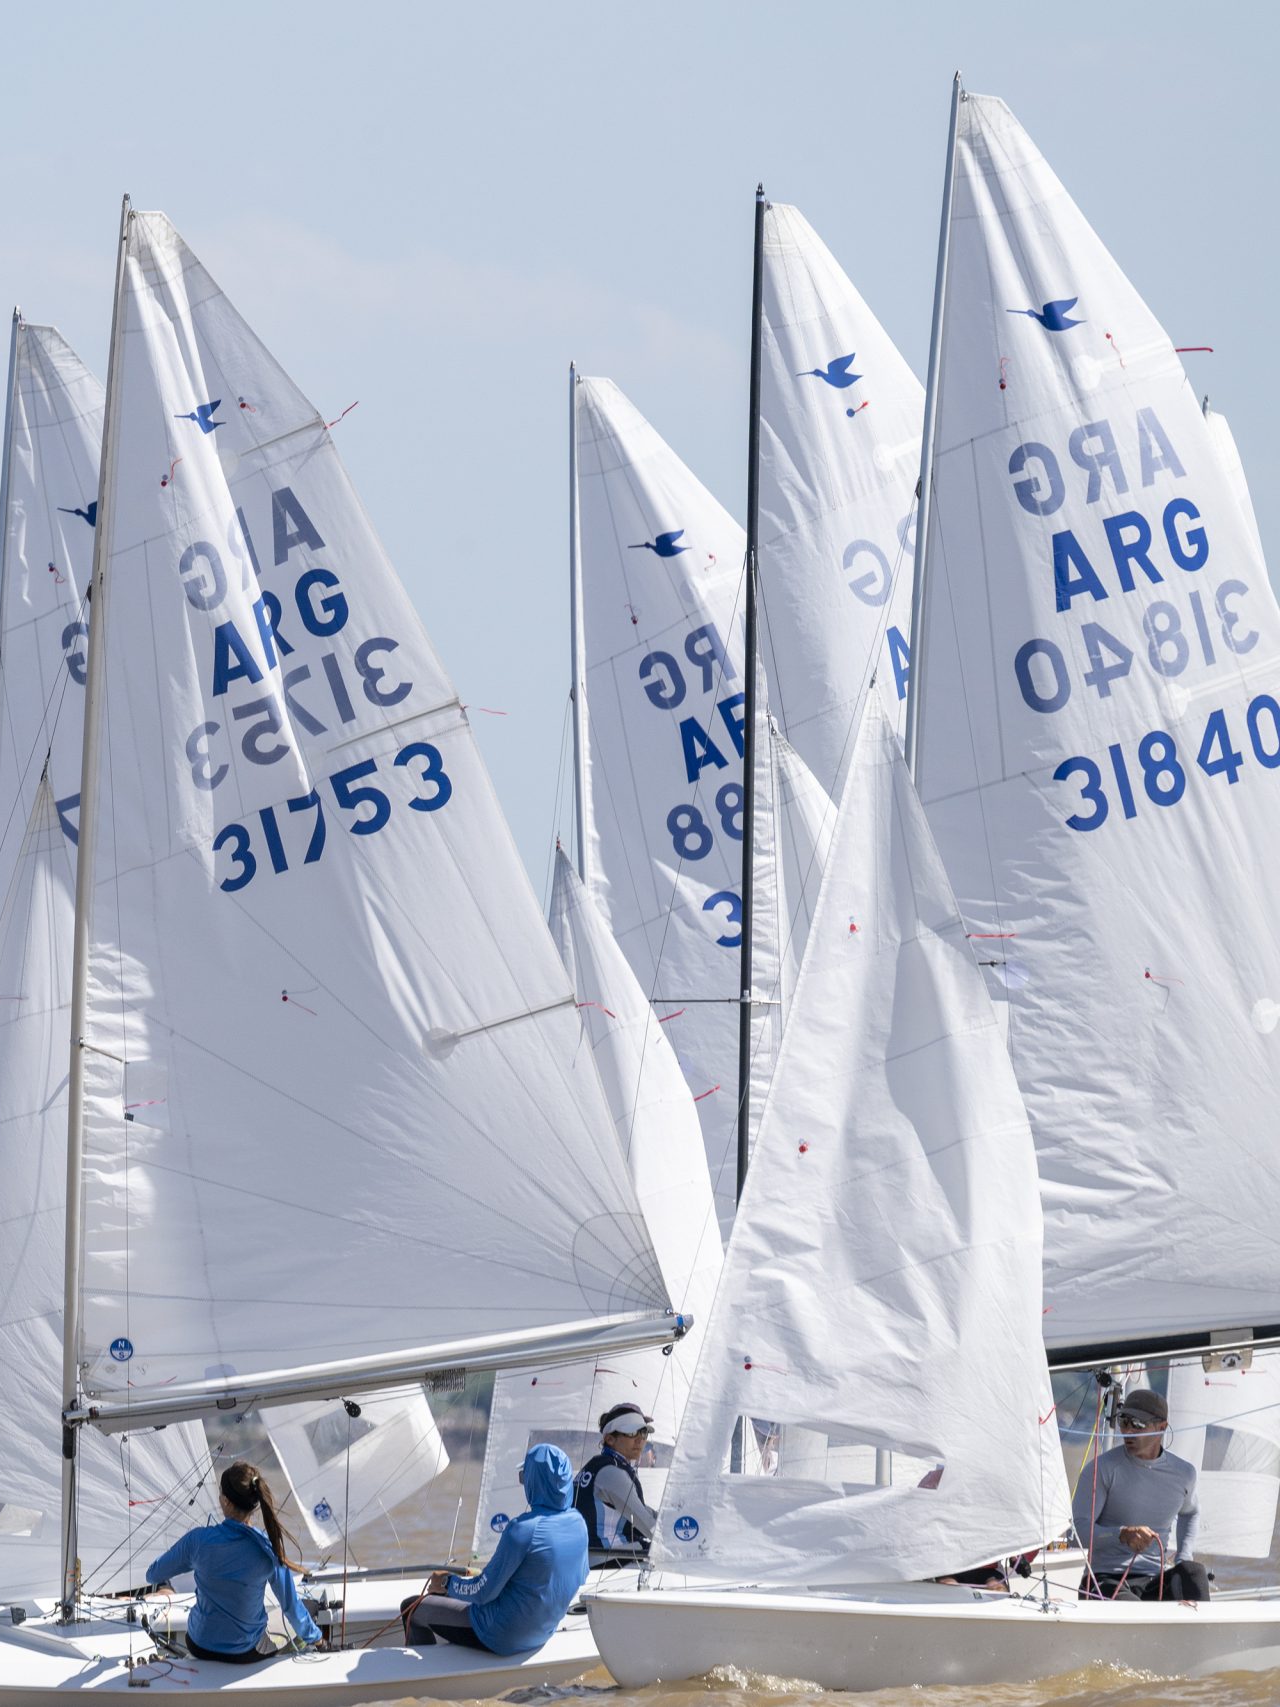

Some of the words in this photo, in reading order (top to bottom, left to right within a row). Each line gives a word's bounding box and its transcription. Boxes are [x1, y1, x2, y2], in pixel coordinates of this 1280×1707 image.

[1052, 497, 1209, 614] ARG
[212, 568, 349, 697] ARG
[212, 741, 453, 893] 31753
[1052, 694, 1280, 832] 31840
